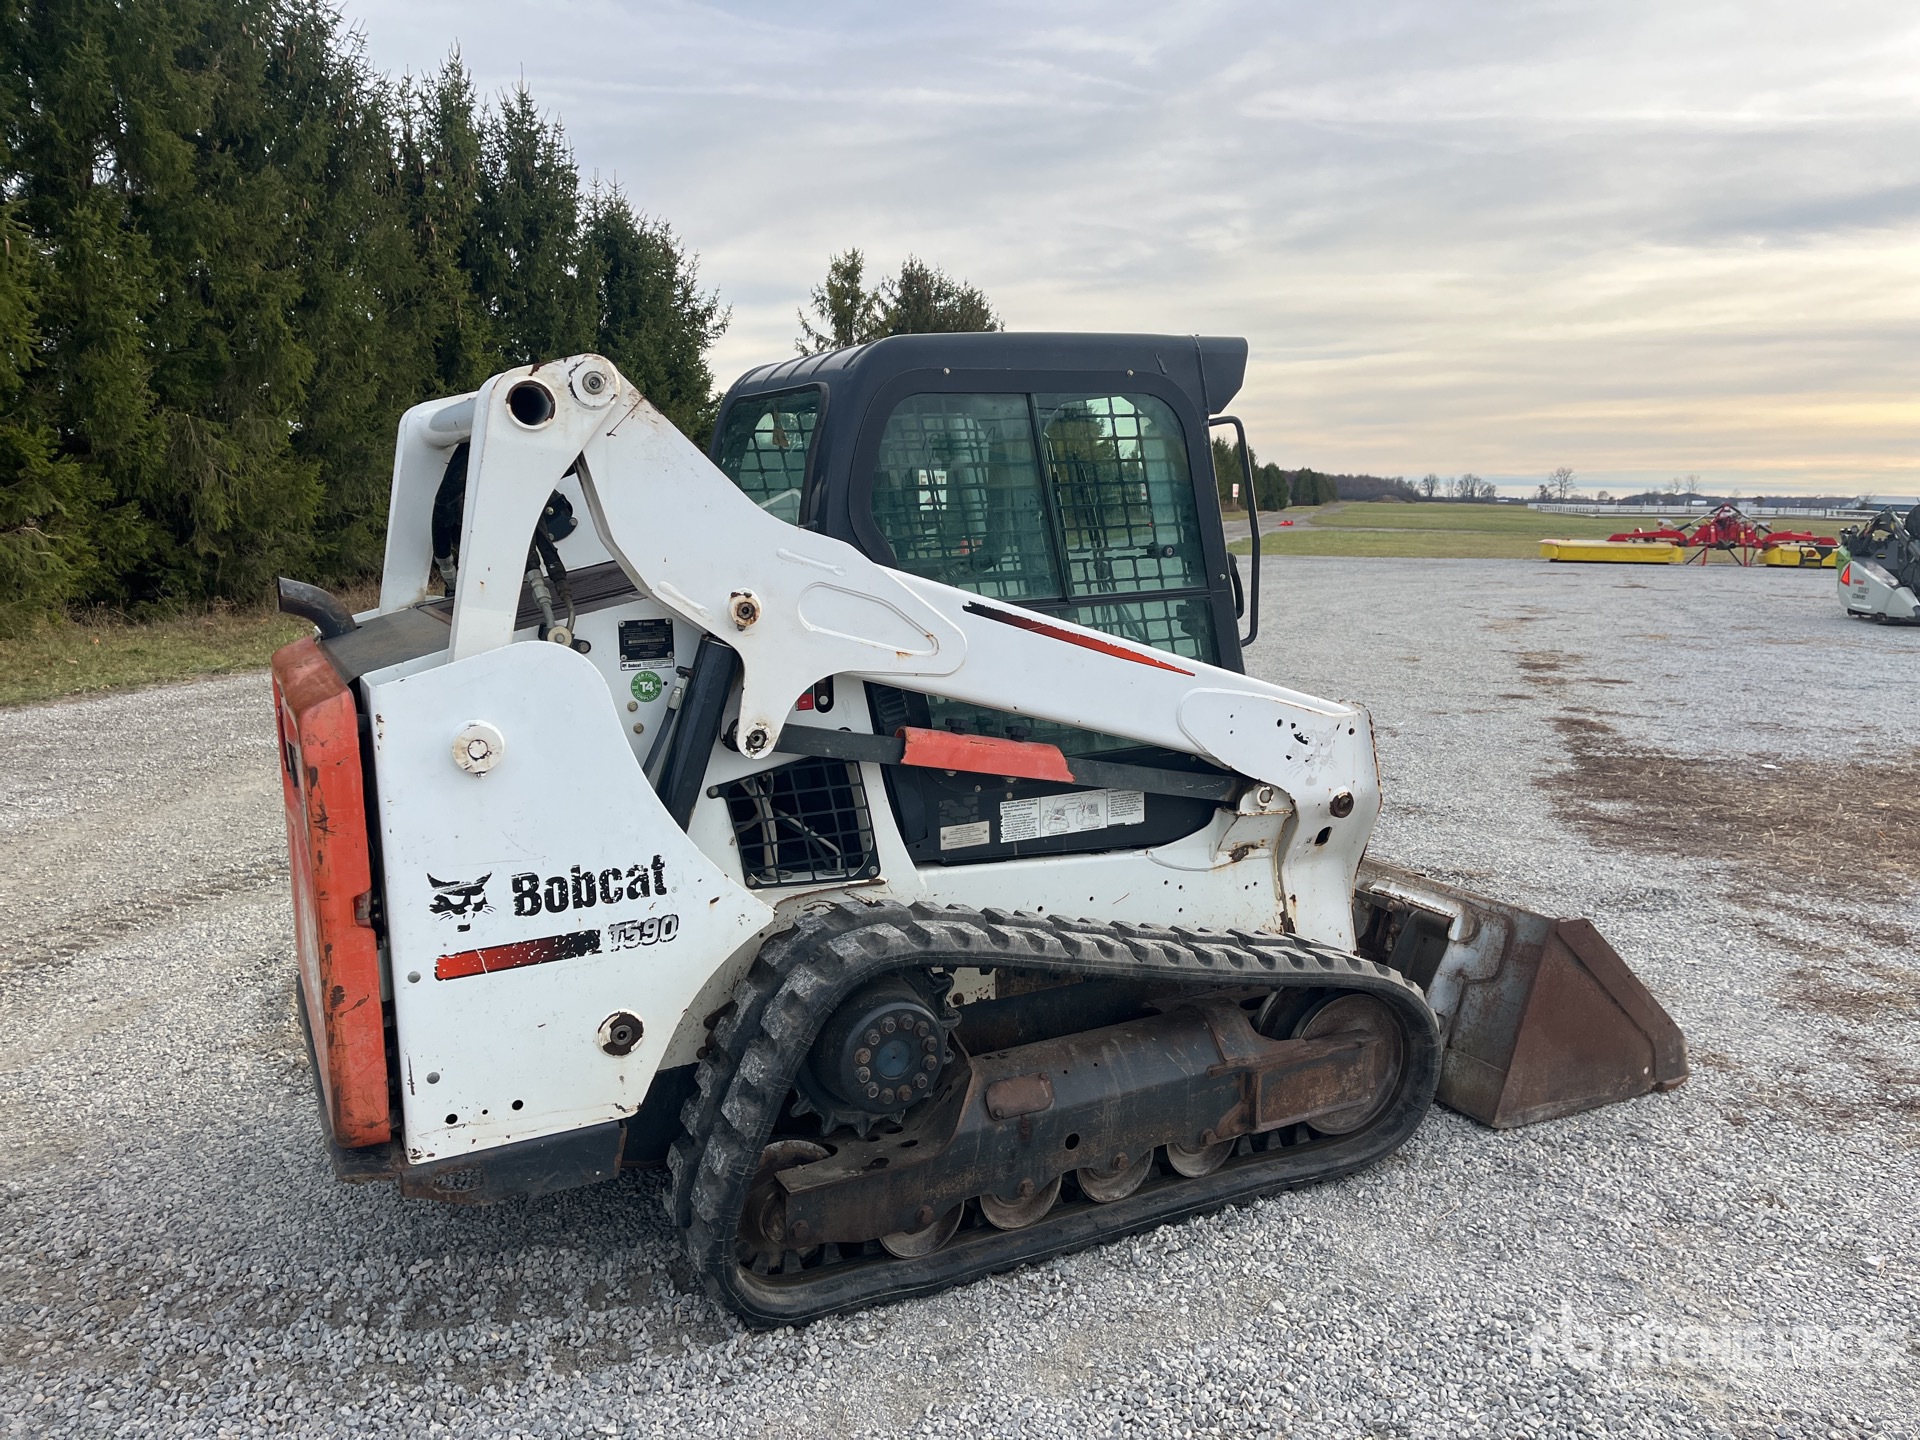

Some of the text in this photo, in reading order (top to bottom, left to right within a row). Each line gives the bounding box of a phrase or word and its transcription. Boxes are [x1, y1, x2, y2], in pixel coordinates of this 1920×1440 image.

[640, 681, 654, 692] T4
[511, 854, 667, 917] Bobcat
[608, 913, 679, 952] T590
